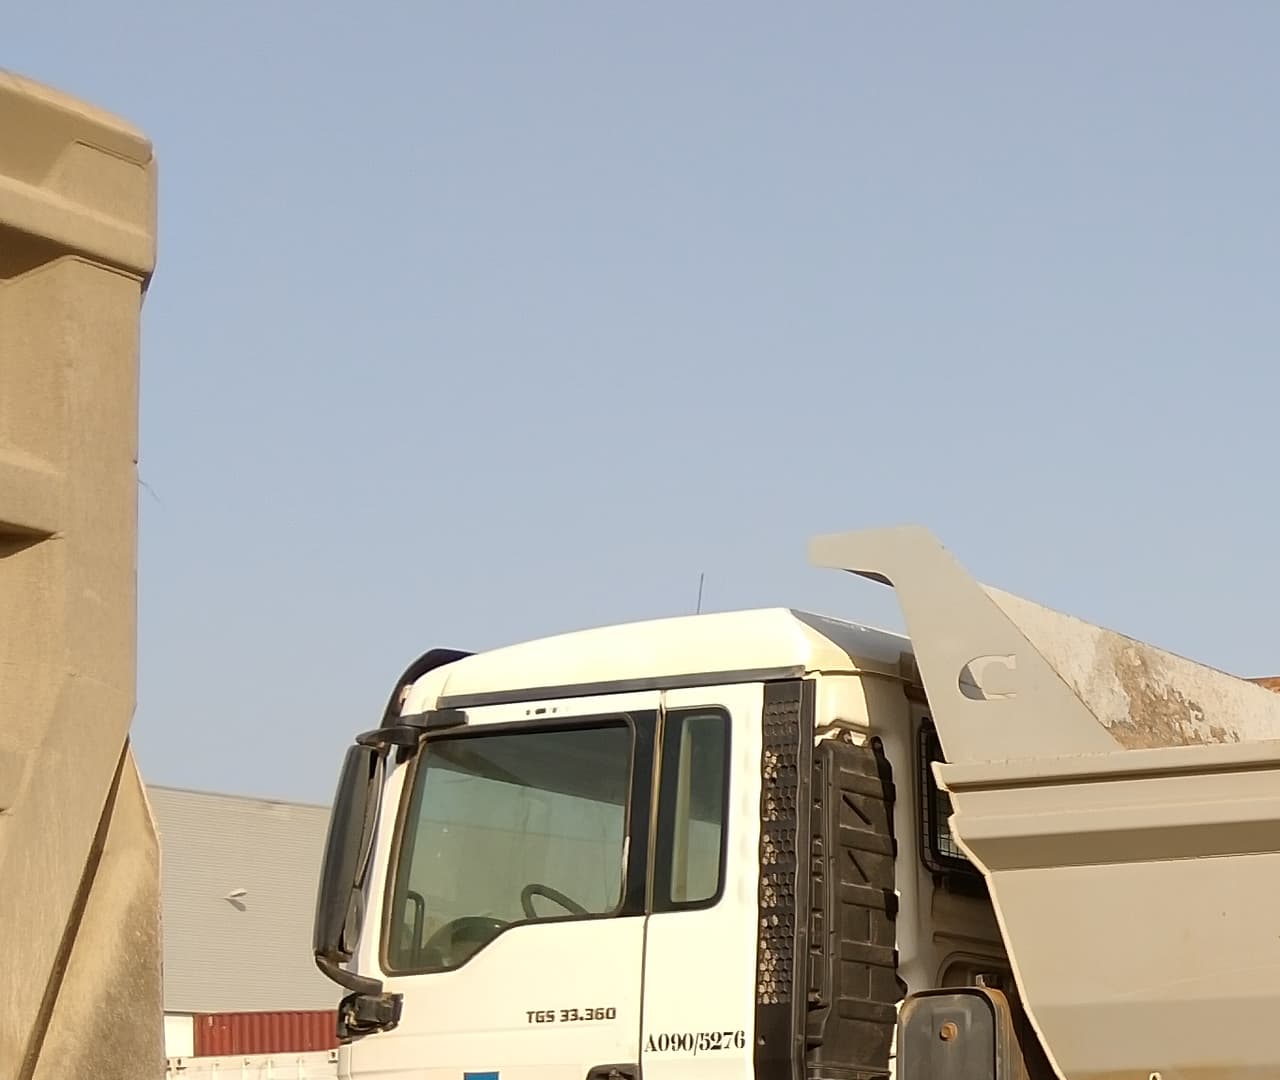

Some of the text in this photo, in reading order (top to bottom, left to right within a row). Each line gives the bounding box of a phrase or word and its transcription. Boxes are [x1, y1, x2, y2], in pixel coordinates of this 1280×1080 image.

[526, 1007, 616, 1023] TGS 33.360
[644, 1030, 746, 1056] A090/5276
